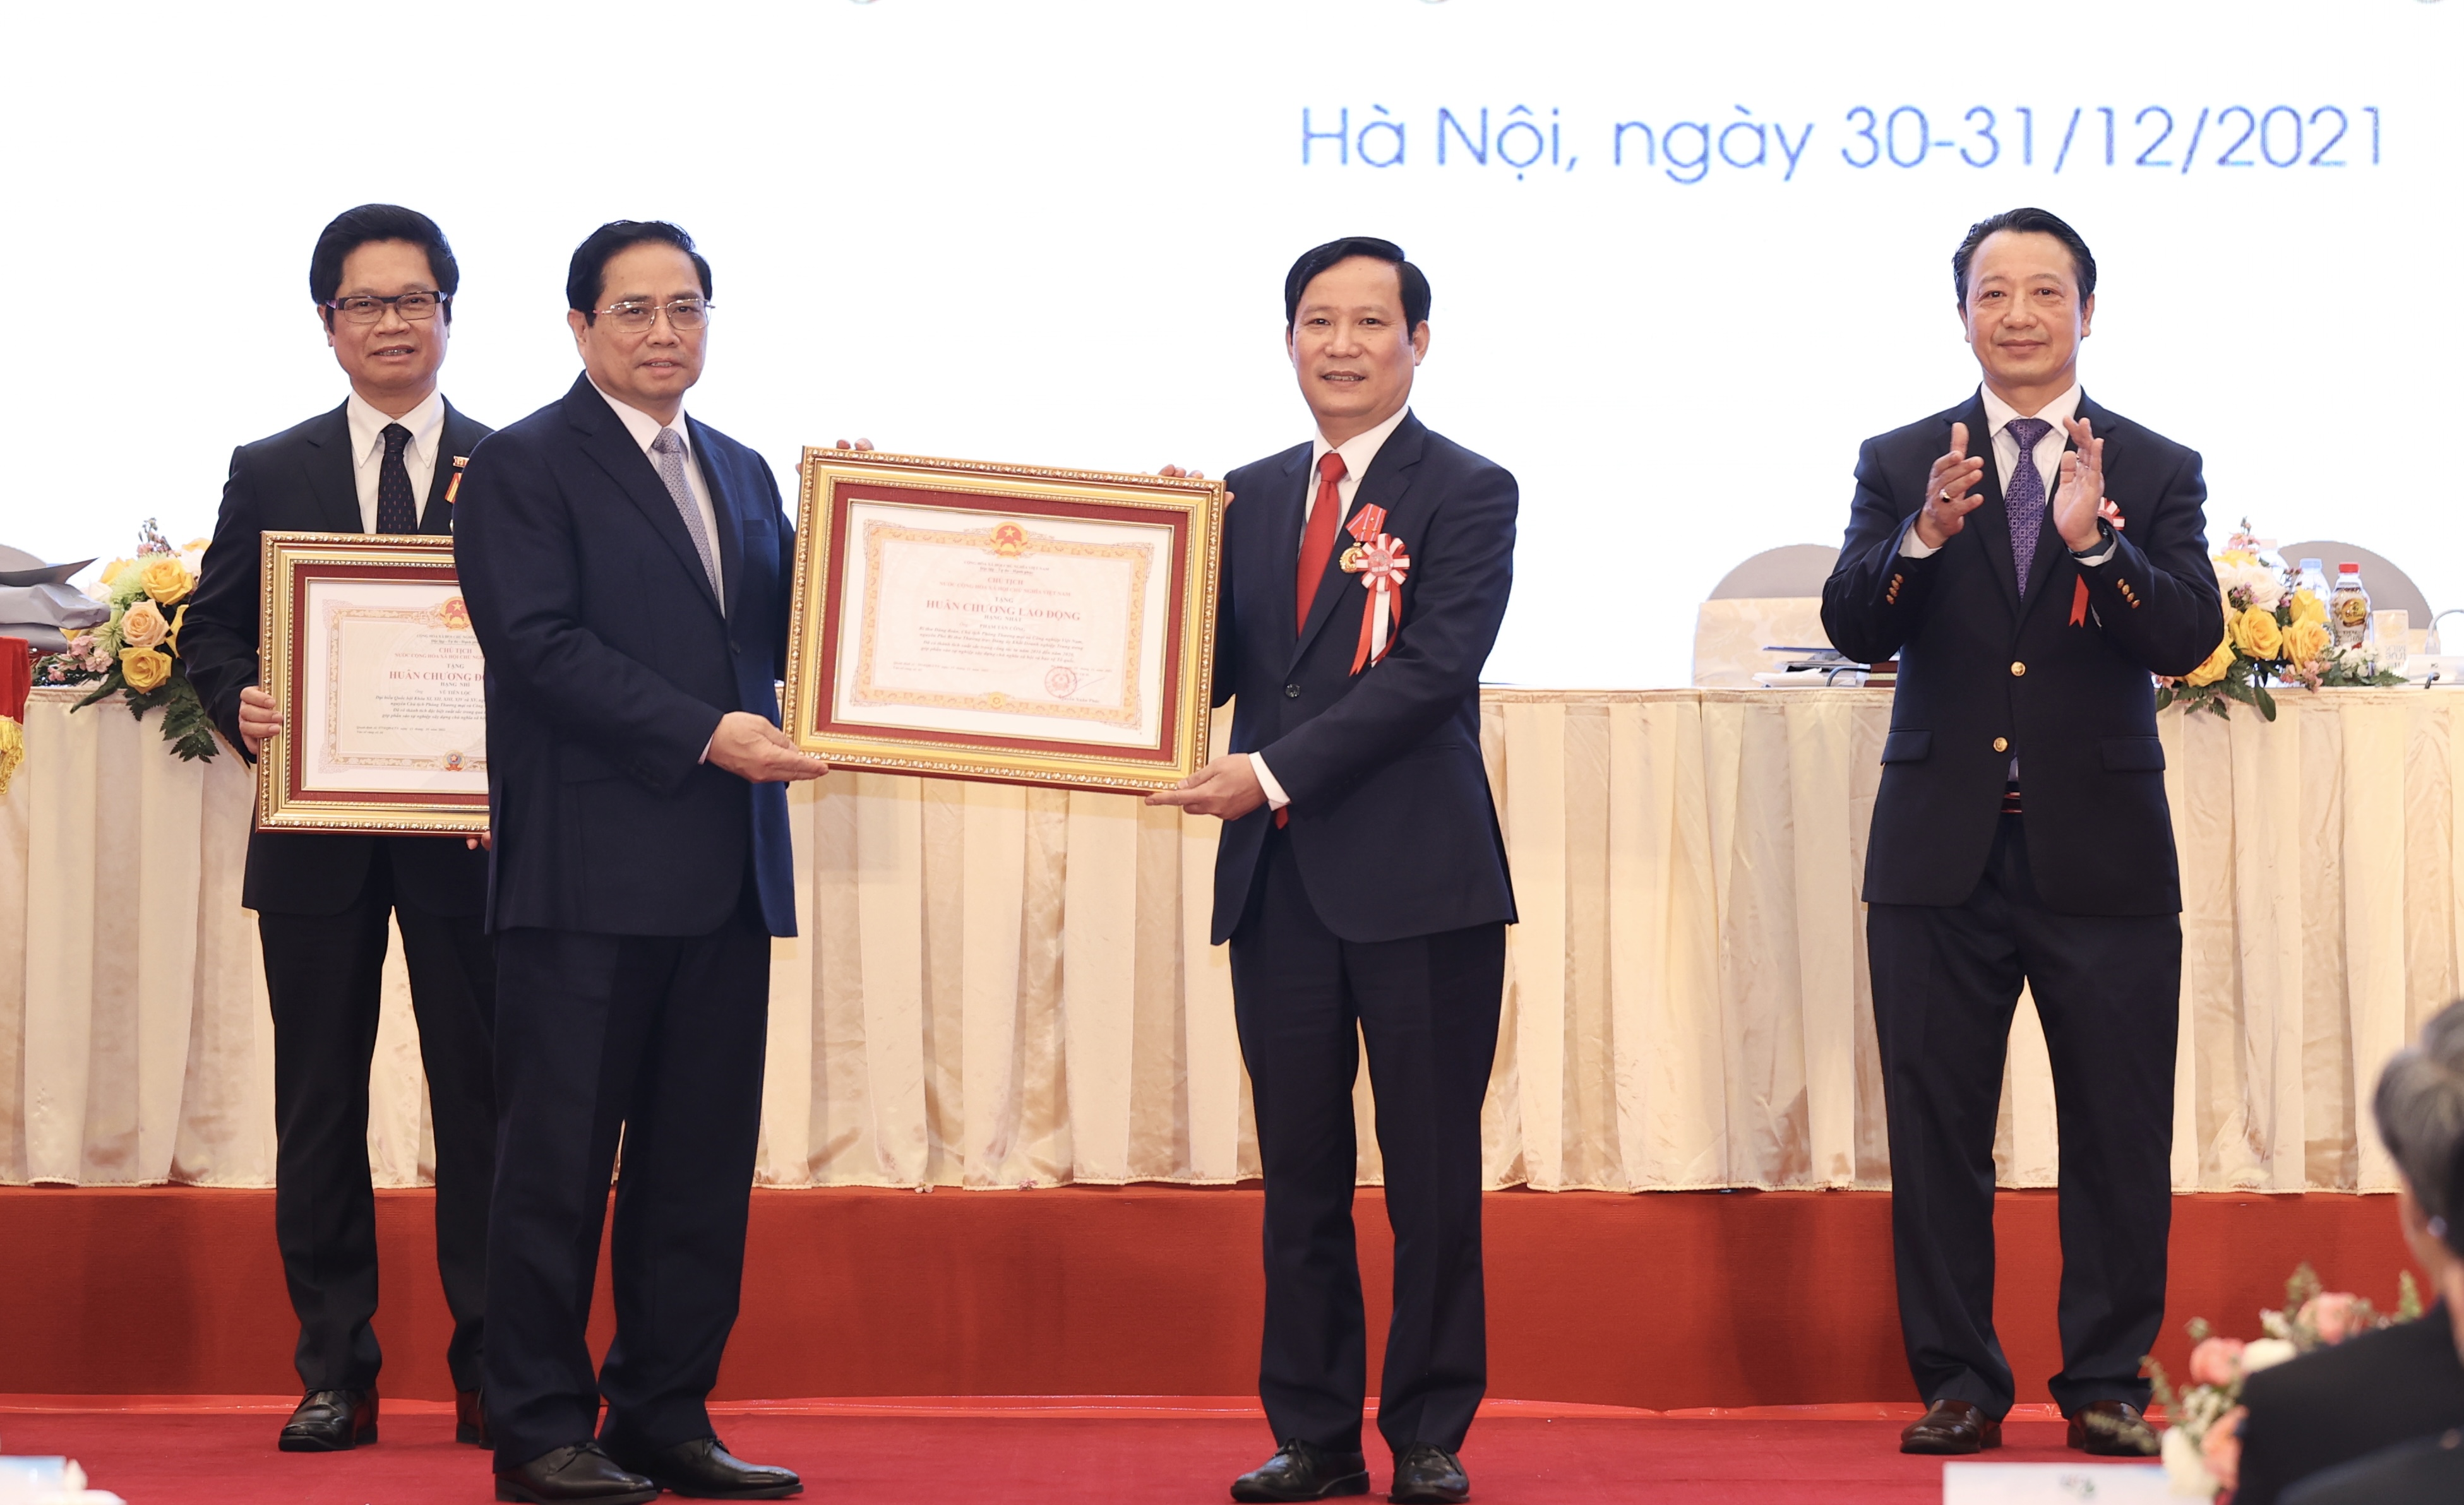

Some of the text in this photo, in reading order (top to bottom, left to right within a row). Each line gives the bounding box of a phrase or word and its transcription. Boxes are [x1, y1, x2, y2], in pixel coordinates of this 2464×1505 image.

[1302, 104, 2379, 184] Hà Nội, ngày 30-31/12/2021
[390, 669, 419, 679] HUÂN
[423, 671, 471, 681] CHƯƠNG
